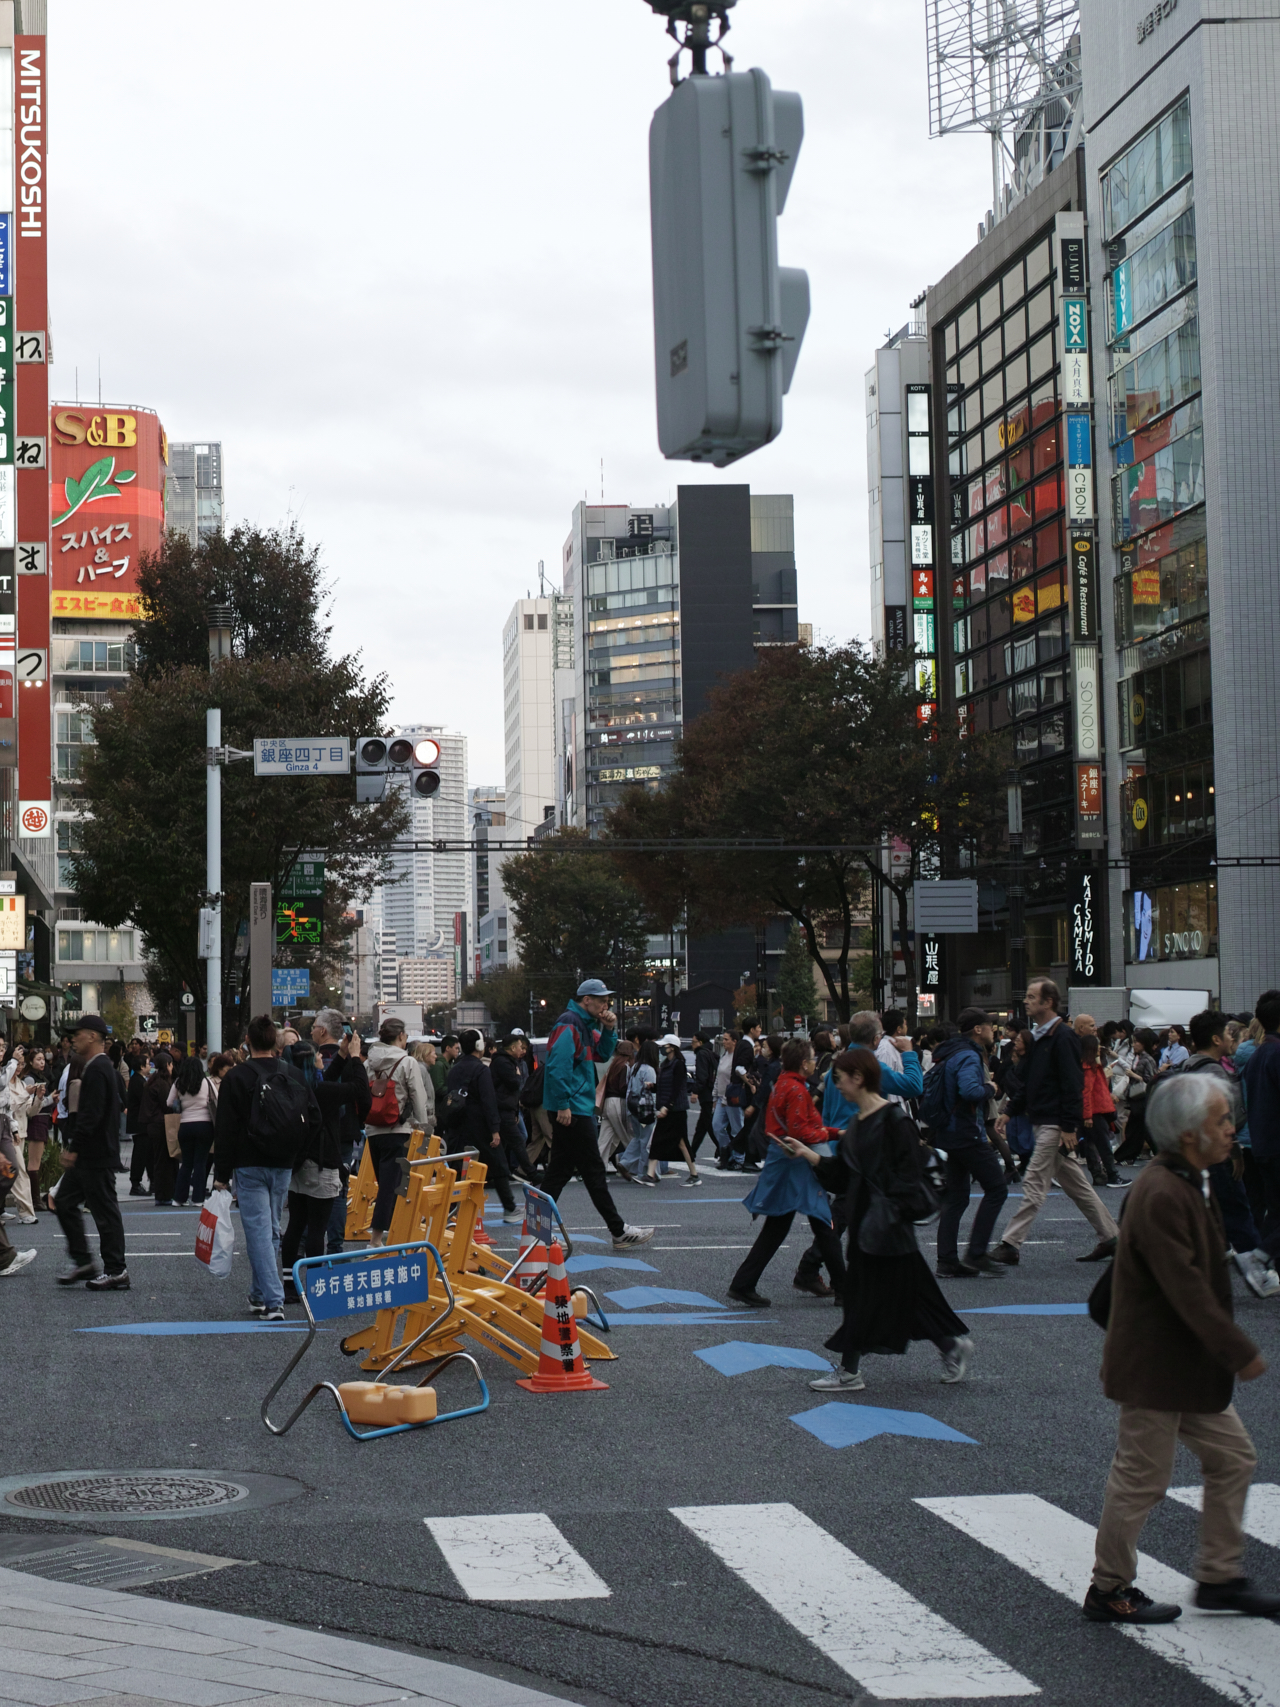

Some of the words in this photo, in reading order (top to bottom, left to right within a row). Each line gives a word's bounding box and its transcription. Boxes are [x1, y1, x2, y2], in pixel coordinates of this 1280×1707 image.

[20, 49, 42, 237] MITSUKOSHI
[1068, 244, 1080, 282] BUMP
[1069, 304, 1082, 343] NOVA
[1072, 357, 1083, 399] 大月真珠
[54, 411, 137, 447] S&B
[61, 522, 133, 553] スパイス
[76, 555, 131, 584] ハーブ
[1077, 555, 1088, 576] Café
[1080, 577, 1088, 585] &
[1080, 586, 1089, 636] Restaurant
[1080, 680, 1095, 749] SONOKO
[260, 740, 286, 748] 中央区
[261, 747, 343, 763] 銀座四丁目
[286, 763, 309, 771] Ginza
[312, 763, 319, 771] 4
[1088, 768, 1099, 796] 銀座の
[1080, 774, 1089, 809] ステーキ
[1073, 903, 1083, 972] CAMERA
[1083, 874, 1094, 977] KATSUMIDO
[314, 1263, 421, 1298] 歩行者天国実施中
[347, 1290, 392, 1310] 築地警察署
[554, 1295, 575, 1374] 築地警察署
